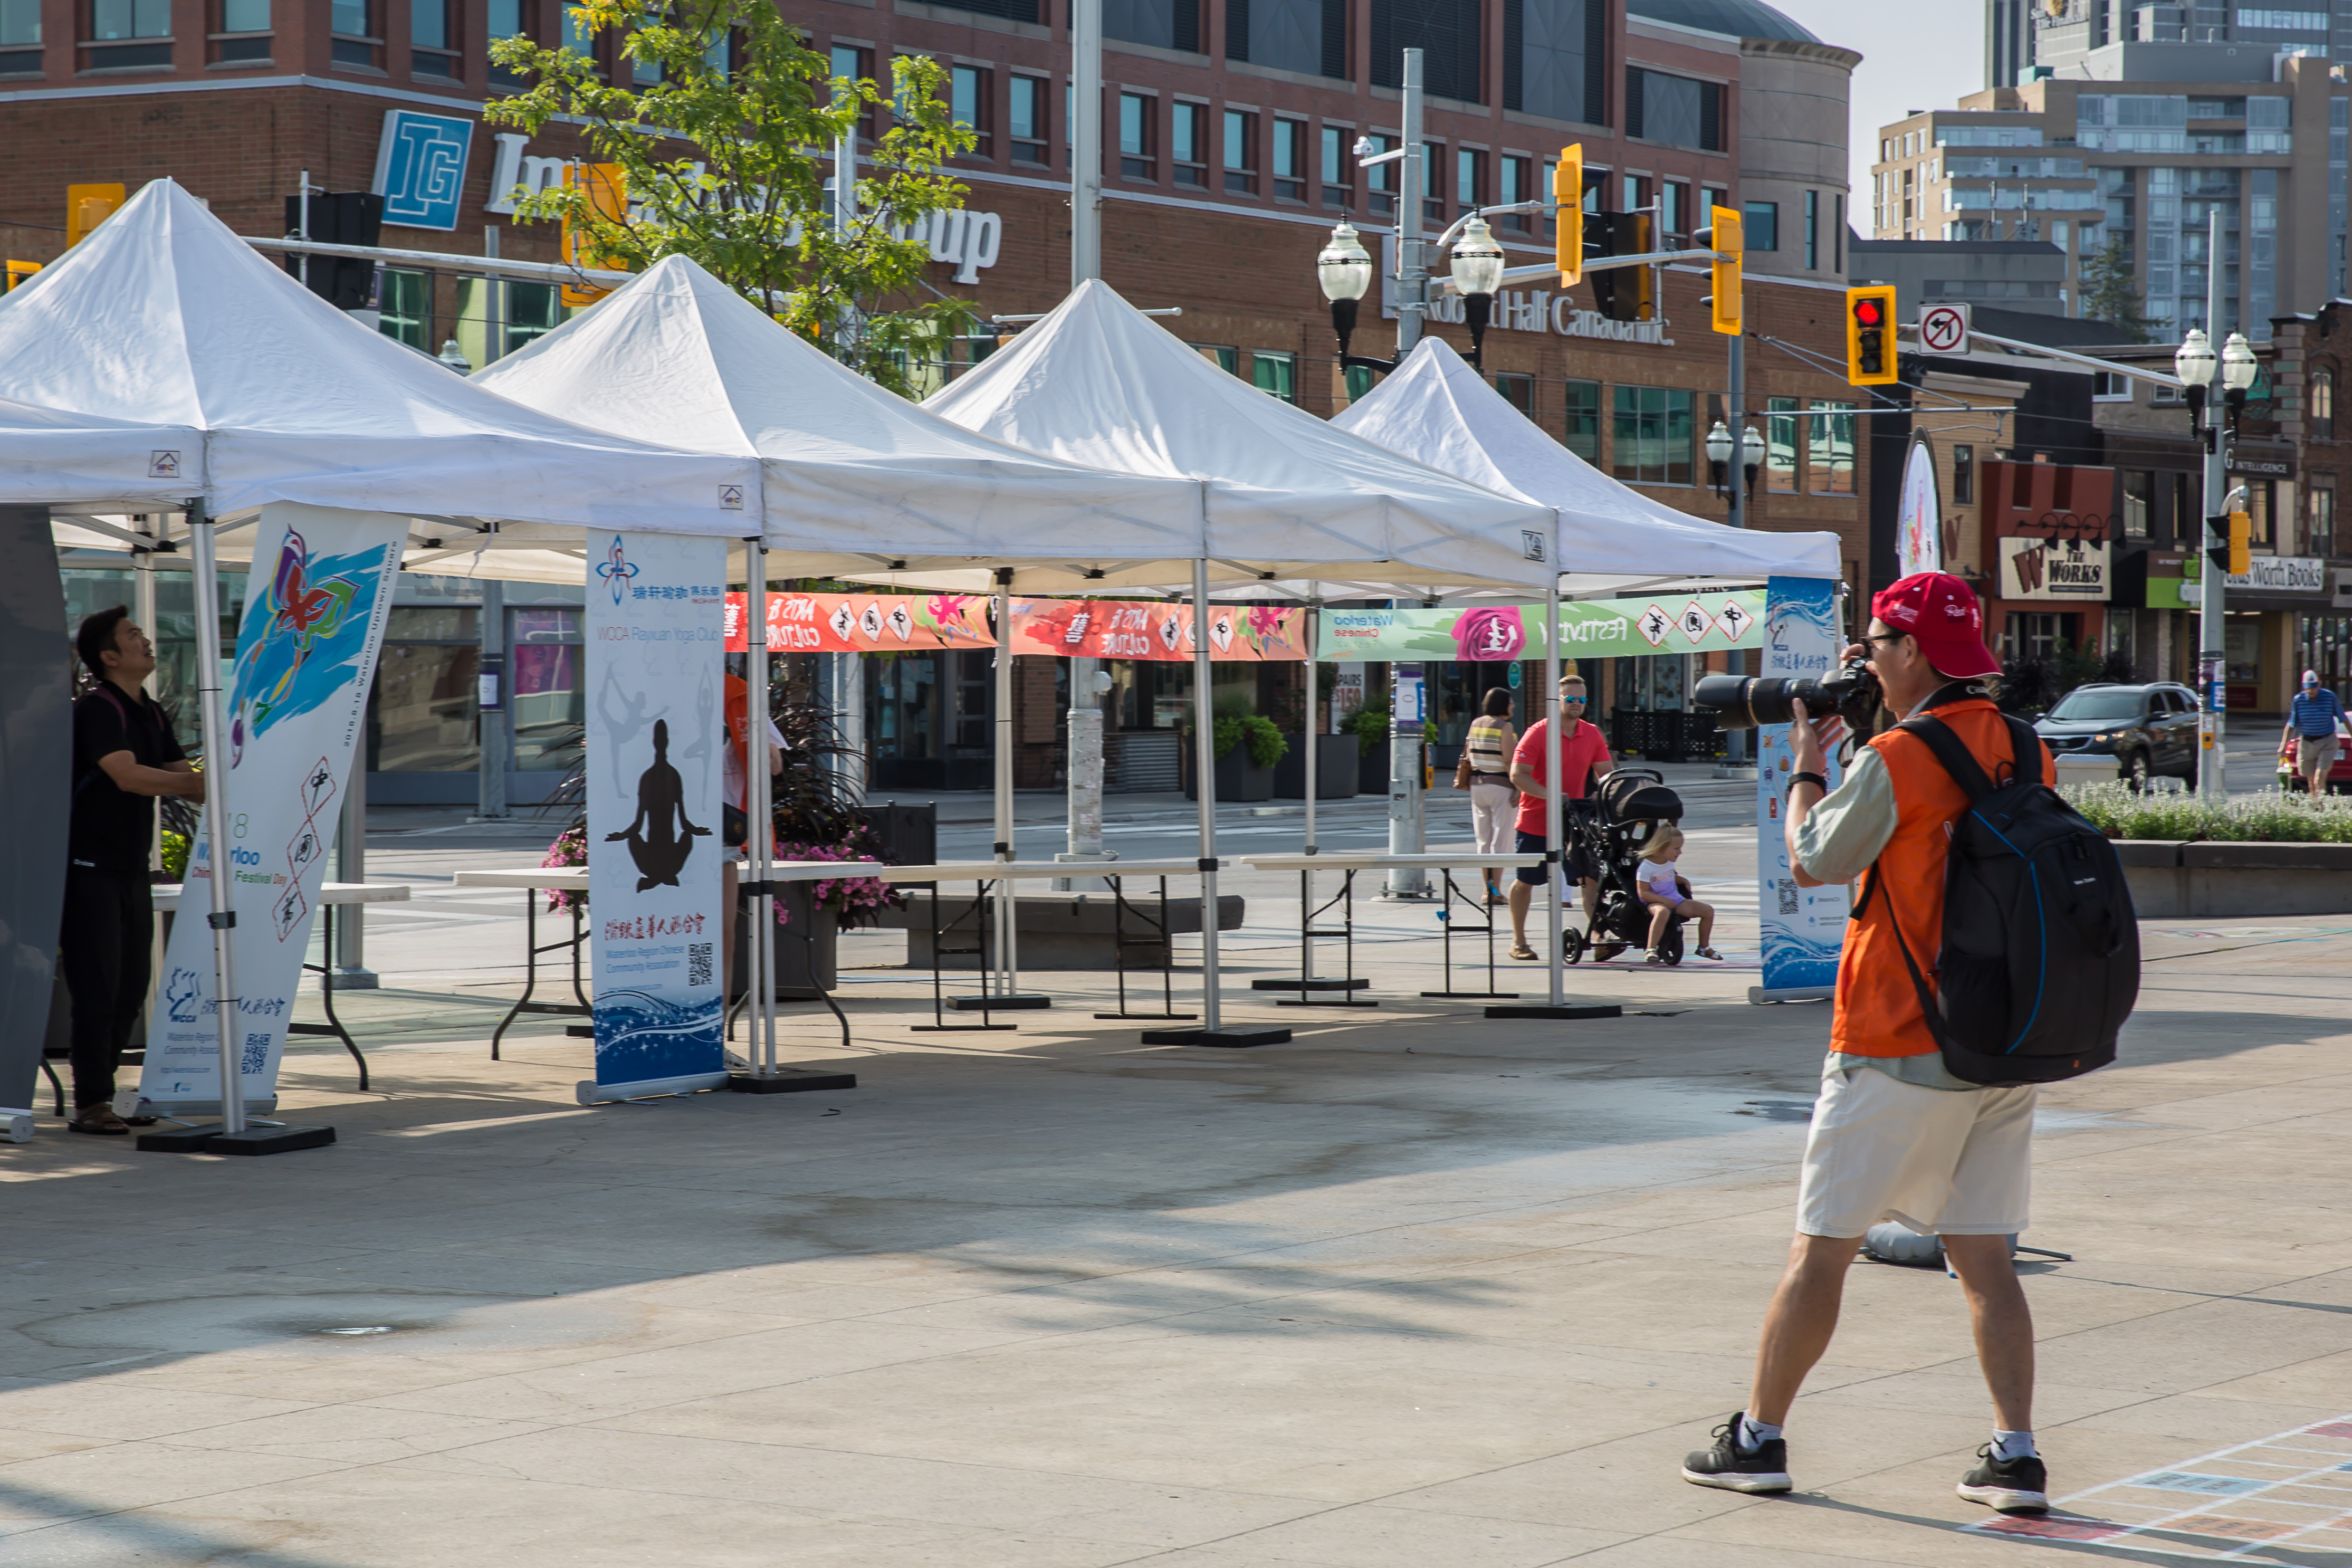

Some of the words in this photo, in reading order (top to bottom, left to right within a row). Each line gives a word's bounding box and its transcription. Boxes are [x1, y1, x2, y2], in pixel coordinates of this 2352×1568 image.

[387, 122, 463, 216] IG
[1499, 290, 1551, 333] Half
[2235, 461, 2287, 473] INTELLIGENCE
[2048, 560, 2102, 584] WORKS
[2251, 560, 2286, 586] Worth
[2287, 561, 2321, 587] Books
[357, 635, 376, 687] Waterloo
[370, 587, 388, 630] Uptown
[382, 541, 398, 582] Square
[597, 626, 630, 641] WCCA
[672, 627, 695, 644] Yoga
[696, 626, 720, 641] Club
[234, 870, 273, 885] Festival
[272, 873, 289, 887] Day
[170, 1015, 197, 1023] WCCA
